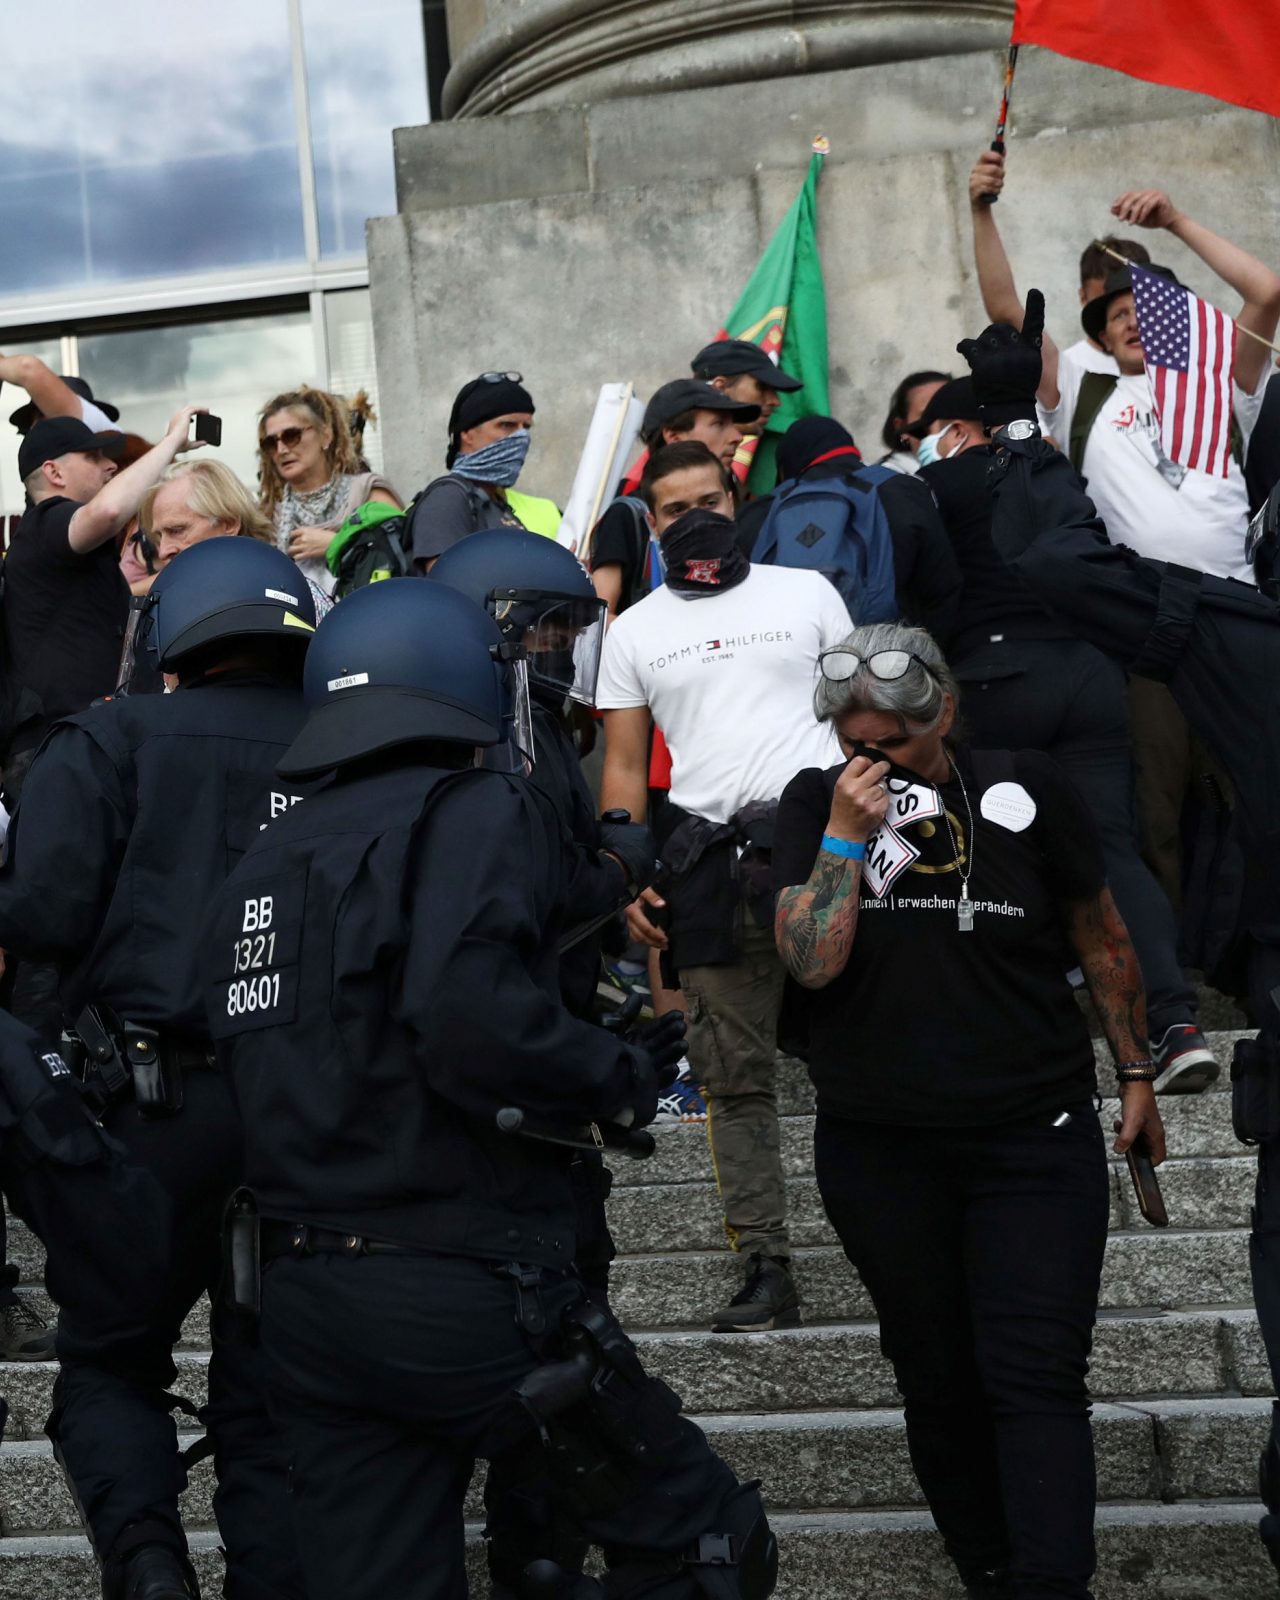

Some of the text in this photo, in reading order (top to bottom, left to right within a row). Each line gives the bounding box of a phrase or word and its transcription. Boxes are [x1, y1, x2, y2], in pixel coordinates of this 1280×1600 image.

[648, 631, 793, 673] TOMMY HILFIGER
[718, 653, 734, 661] 1985
[242, 896, 273, 932] BB
[898, 894, 956, 909] erwachen
[974, 900, 1025, 917] erändern
[234, 931, 276, 974] 1321
[227, 973, 280, 1016] 80601
